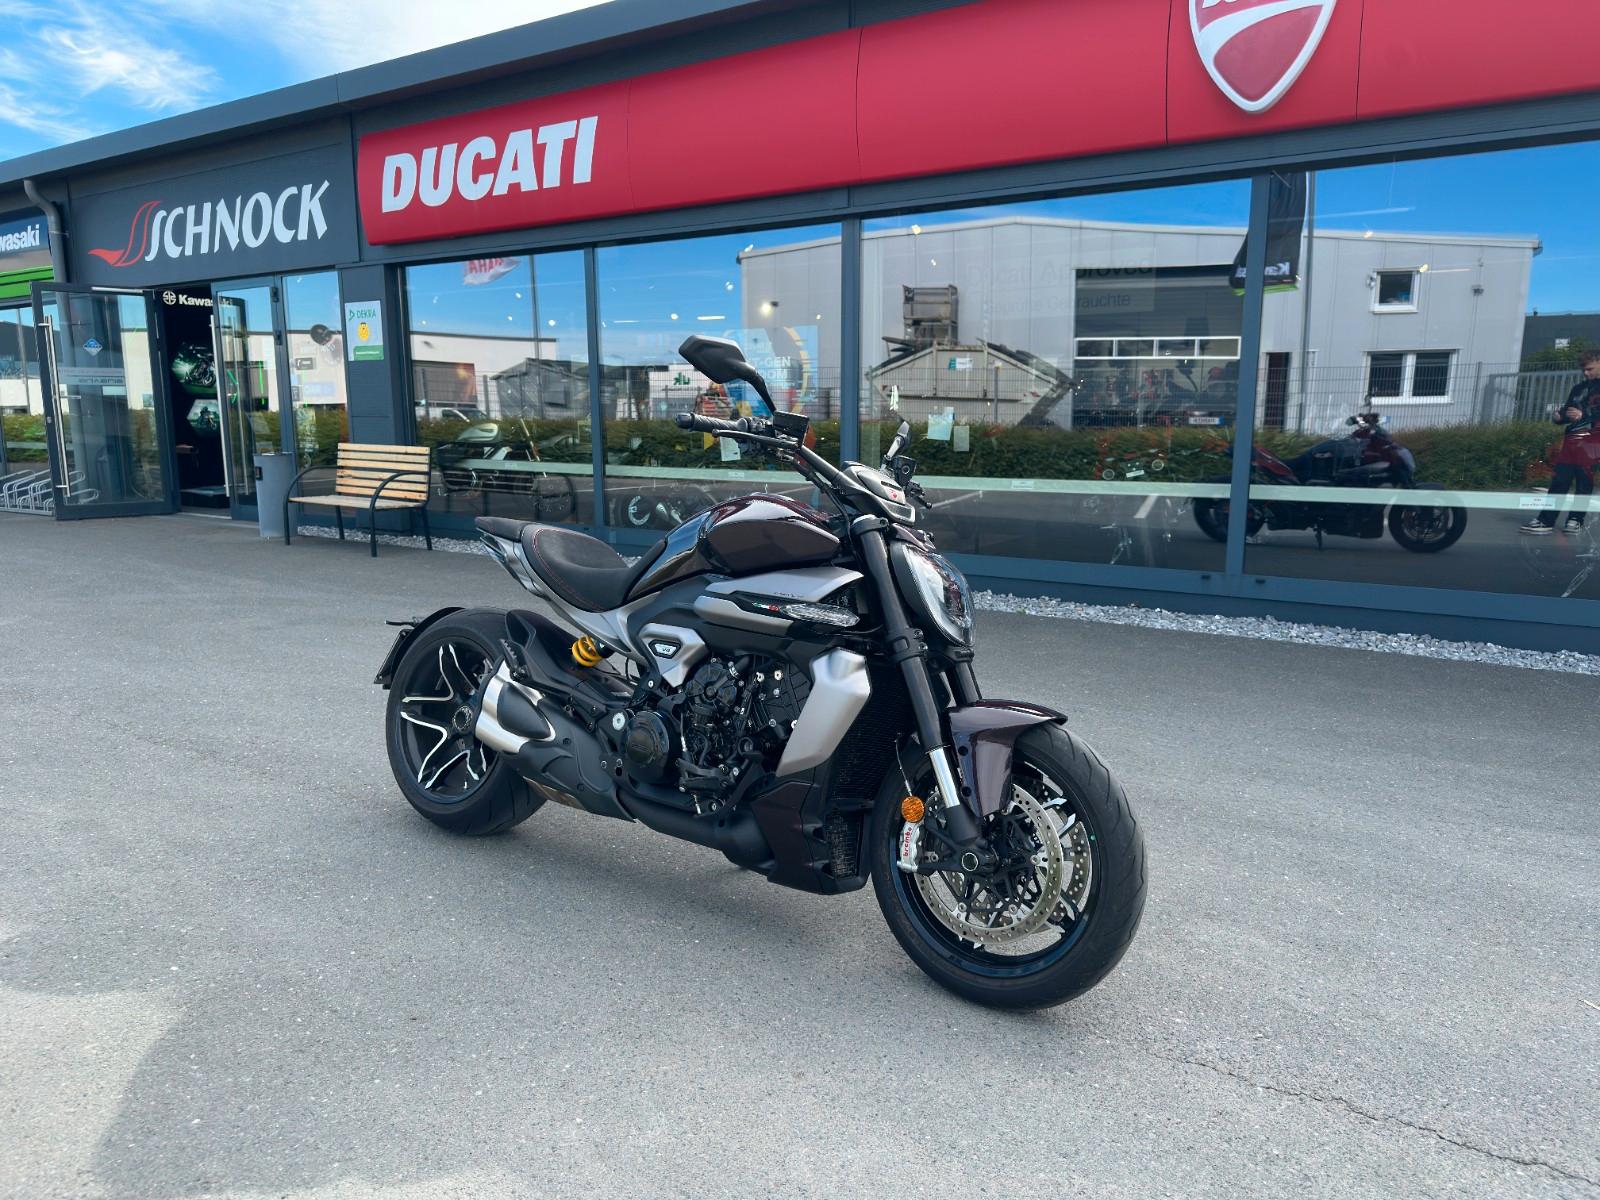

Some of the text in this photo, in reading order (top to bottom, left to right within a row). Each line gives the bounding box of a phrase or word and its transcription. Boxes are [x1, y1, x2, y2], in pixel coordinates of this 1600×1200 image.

[381, 115, 599, 213] DUCATI
[145, 179, 330, 262] SCHNOCK
[356, 309, 377, 319] DEKRA
